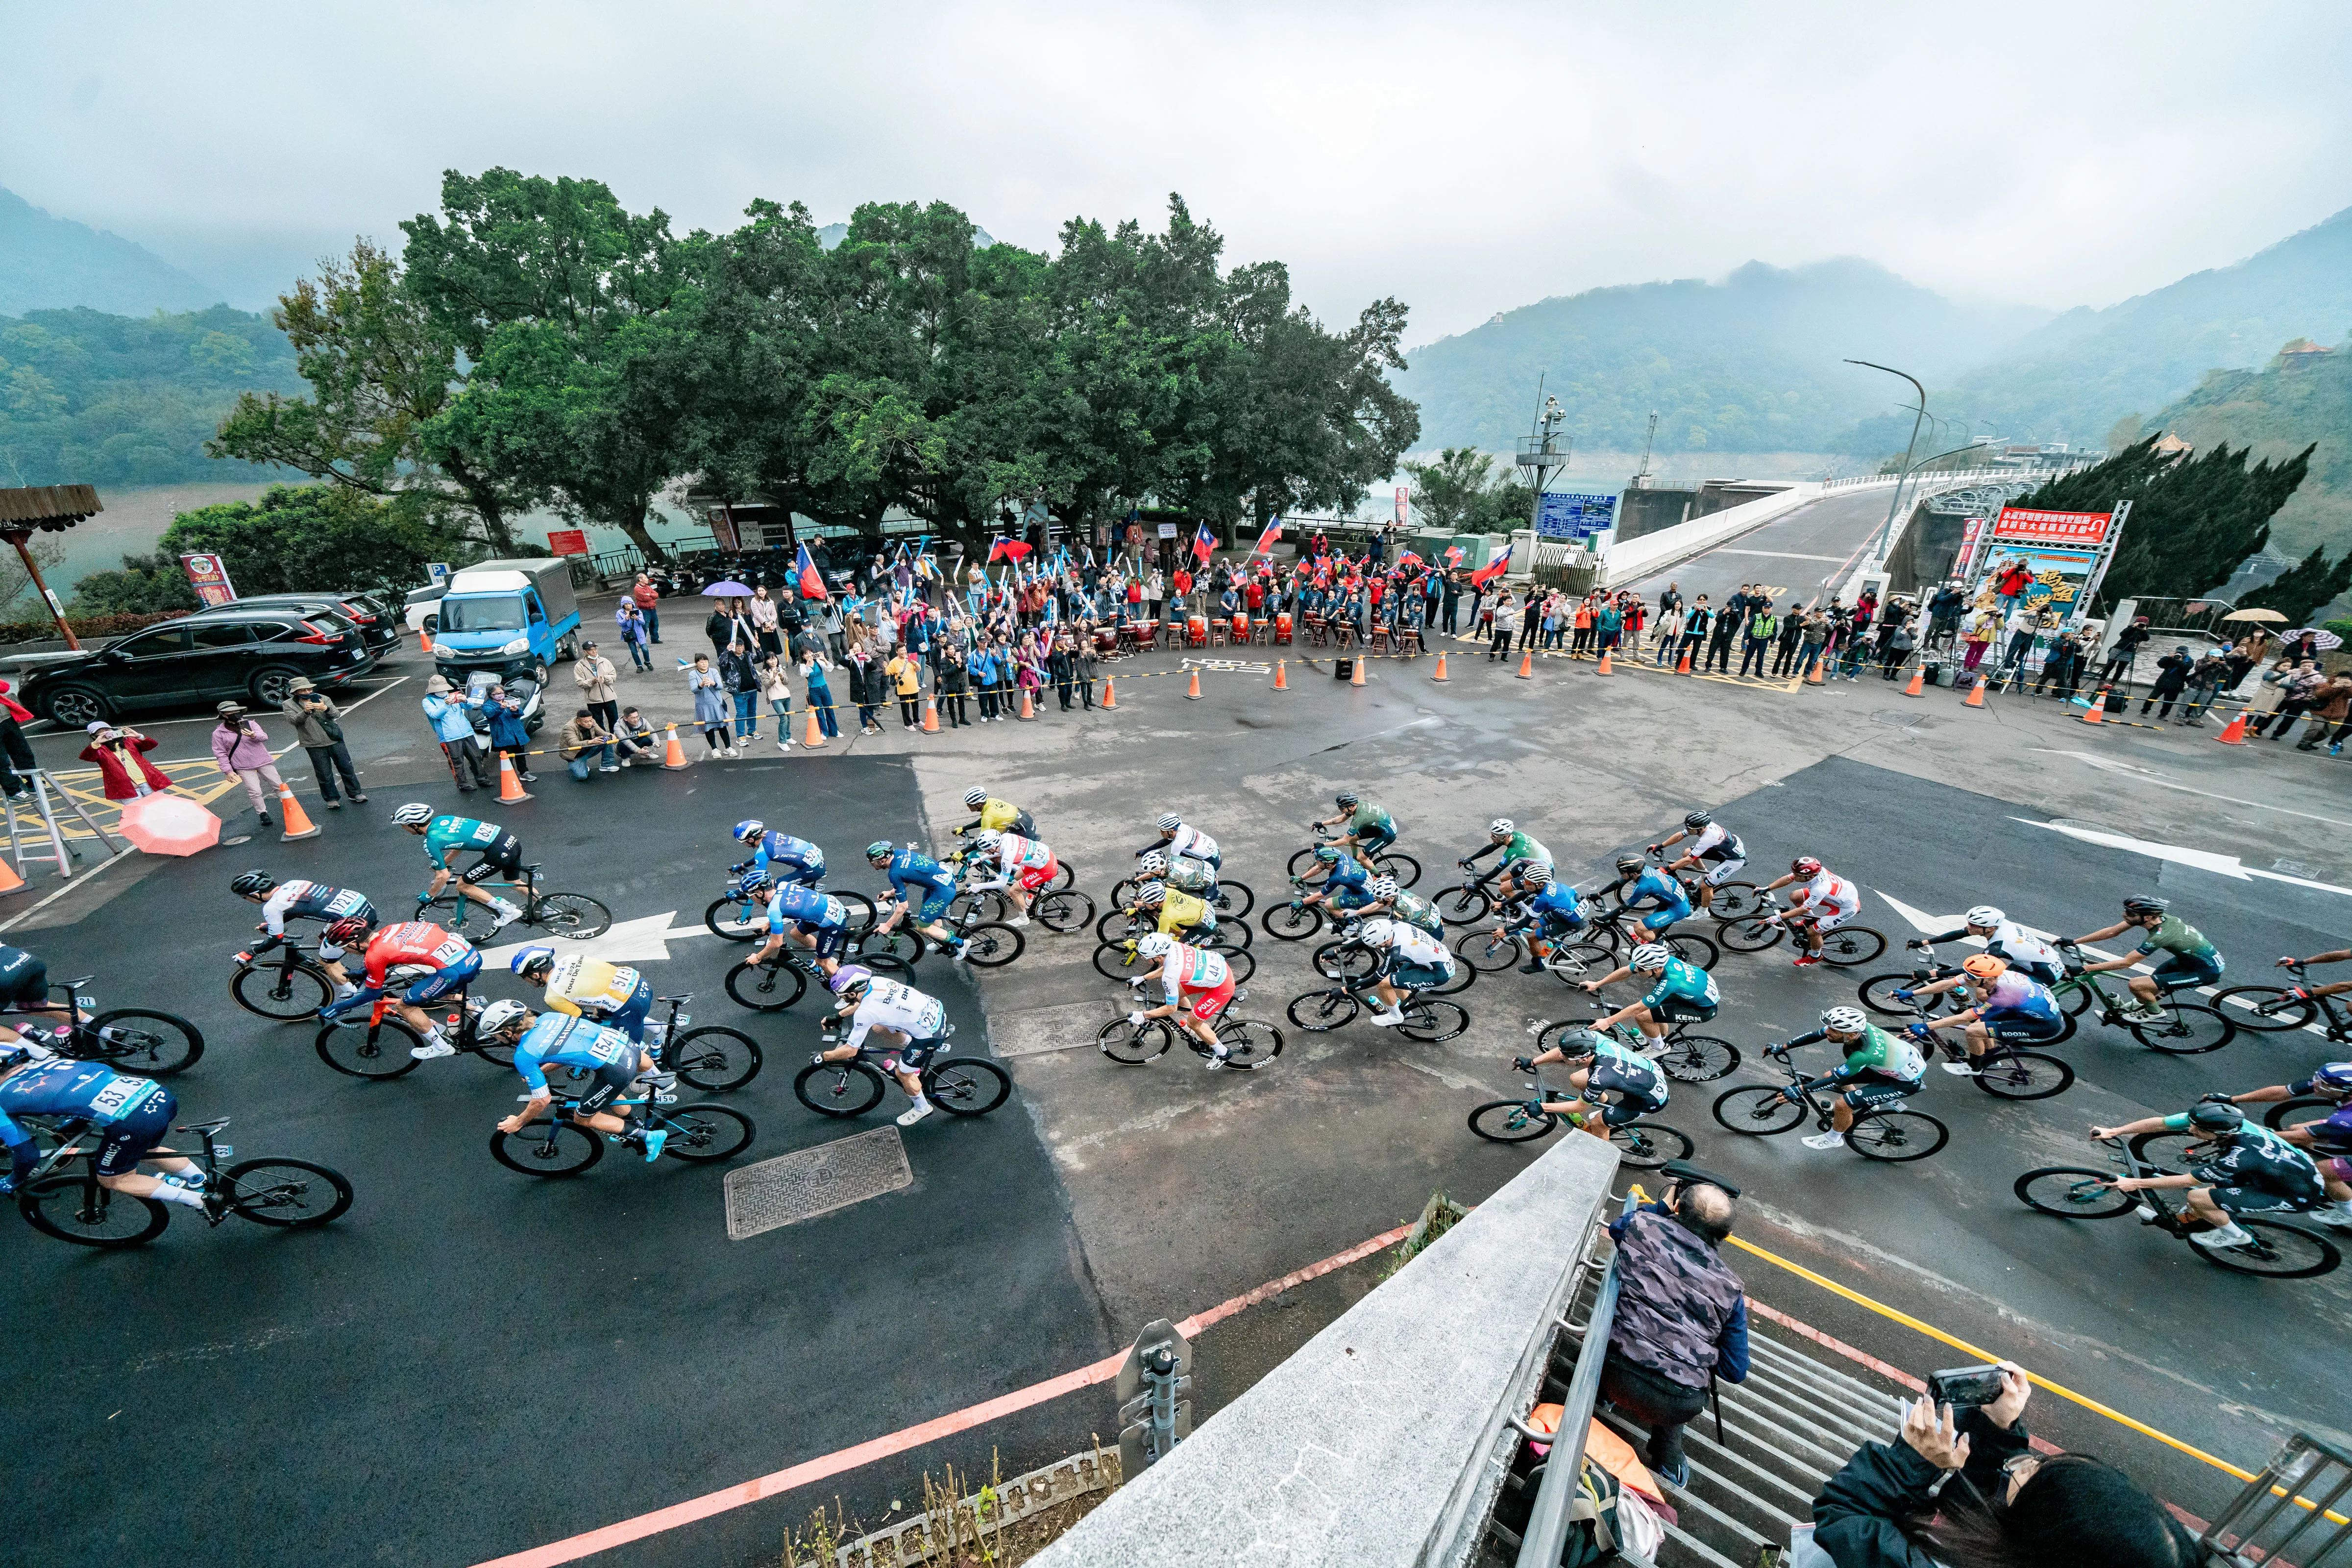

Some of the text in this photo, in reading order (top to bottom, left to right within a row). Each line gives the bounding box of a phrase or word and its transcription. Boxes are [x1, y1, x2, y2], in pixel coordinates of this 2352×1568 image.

[434, 565, 441, 574] P
[480, 828, 491, 837] 62
[504, 835, 515, 848] KERN
[806, 850, 815, 861] 52
[1036, 849, 1046, 859] 42
[466, 863, 491, 879] KERN
[325, 898, 350, 913] 172
[828, 907, 839, 918] 54
[1577, 901, 1588, 916] 134
[1184, 934, 1202, 945] eykoz
[1617, 925, 1637, 949] WINSPACE
[437, 943, 458, 957] 72
[822, 940, 832, 954] ISRAEL
[1155, 941, 1168, 954] KASK
[1209, 965, 1220, 977] 44
[565, 980, 573, 995] Tour
[572, 969, 579, 981] De
[1162, 980, 1171, 995] solo
[1655, 979, 1668, 996] KERN
[901, 988, 910, 1001] BH
[1198, 998, 1216, 1013] POLTI
[1204, 1003, 1221, 1015] KOMETA
[924, 1012, 937, 1026] 22
[1166, 1020, 1189, 1040] AURUM
[591, 1036, 615, 1058] 154
[1909, 1062, 1919, 1074] 5
[1812, 1082, 1837, 1093] VICTORIA
[97, 1090, 126, 1107] 53
[584, 1084, 613, 1107] TSG
[1863, 1090, 1905, 1102] VICTORIA
[101, 1149, 116, 1167] ISRAEL
